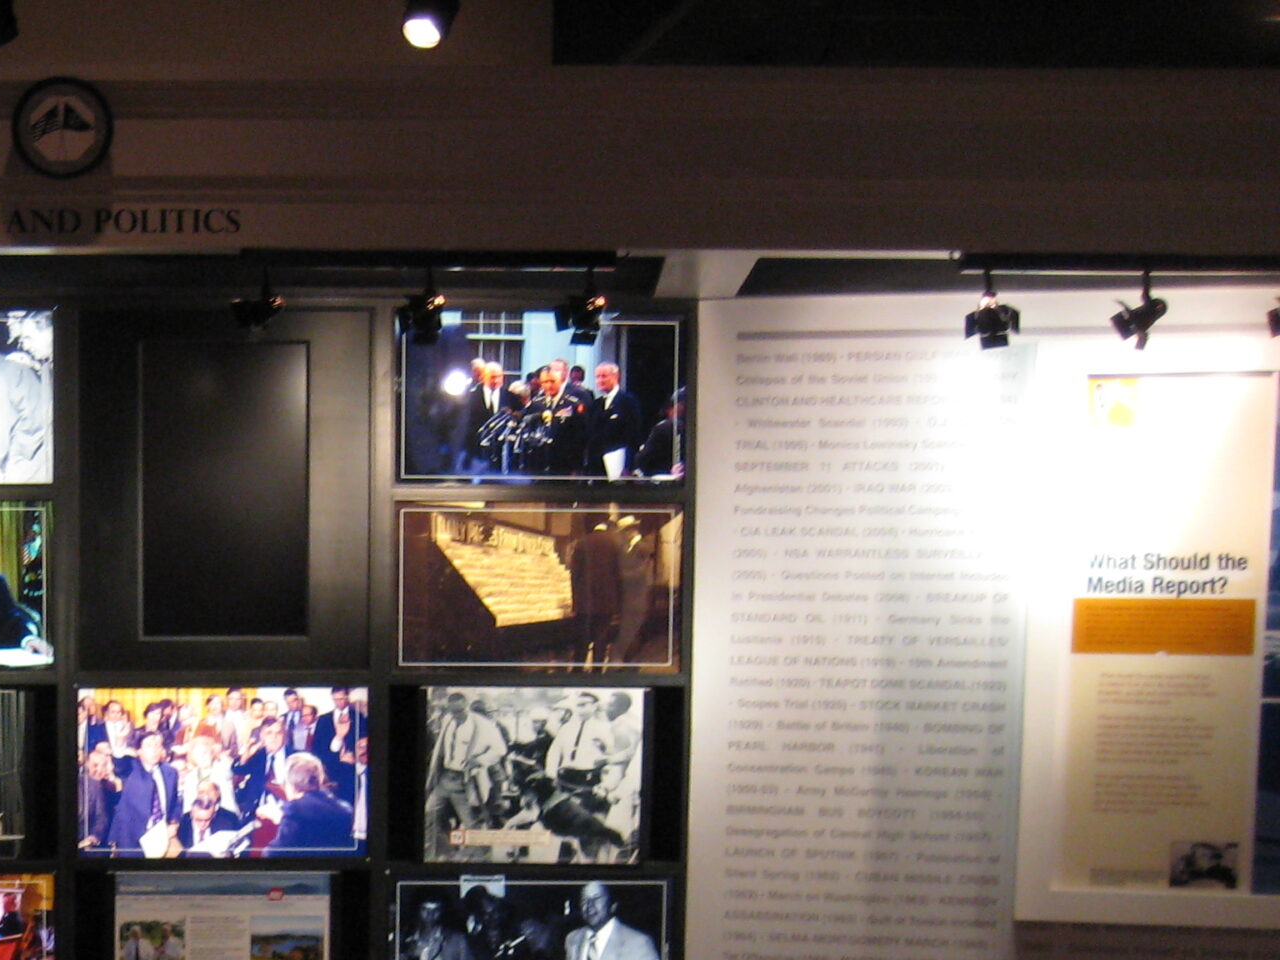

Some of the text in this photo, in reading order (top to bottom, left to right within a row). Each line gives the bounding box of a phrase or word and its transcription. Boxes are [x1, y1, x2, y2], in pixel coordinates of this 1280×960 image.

[5, 209, 81, 234] AND
[94, 209, 241, 234] POLITICS
[1090, 553, 1248, 571] What Should the
[1087, 577, 1228, 598] Media Report?
